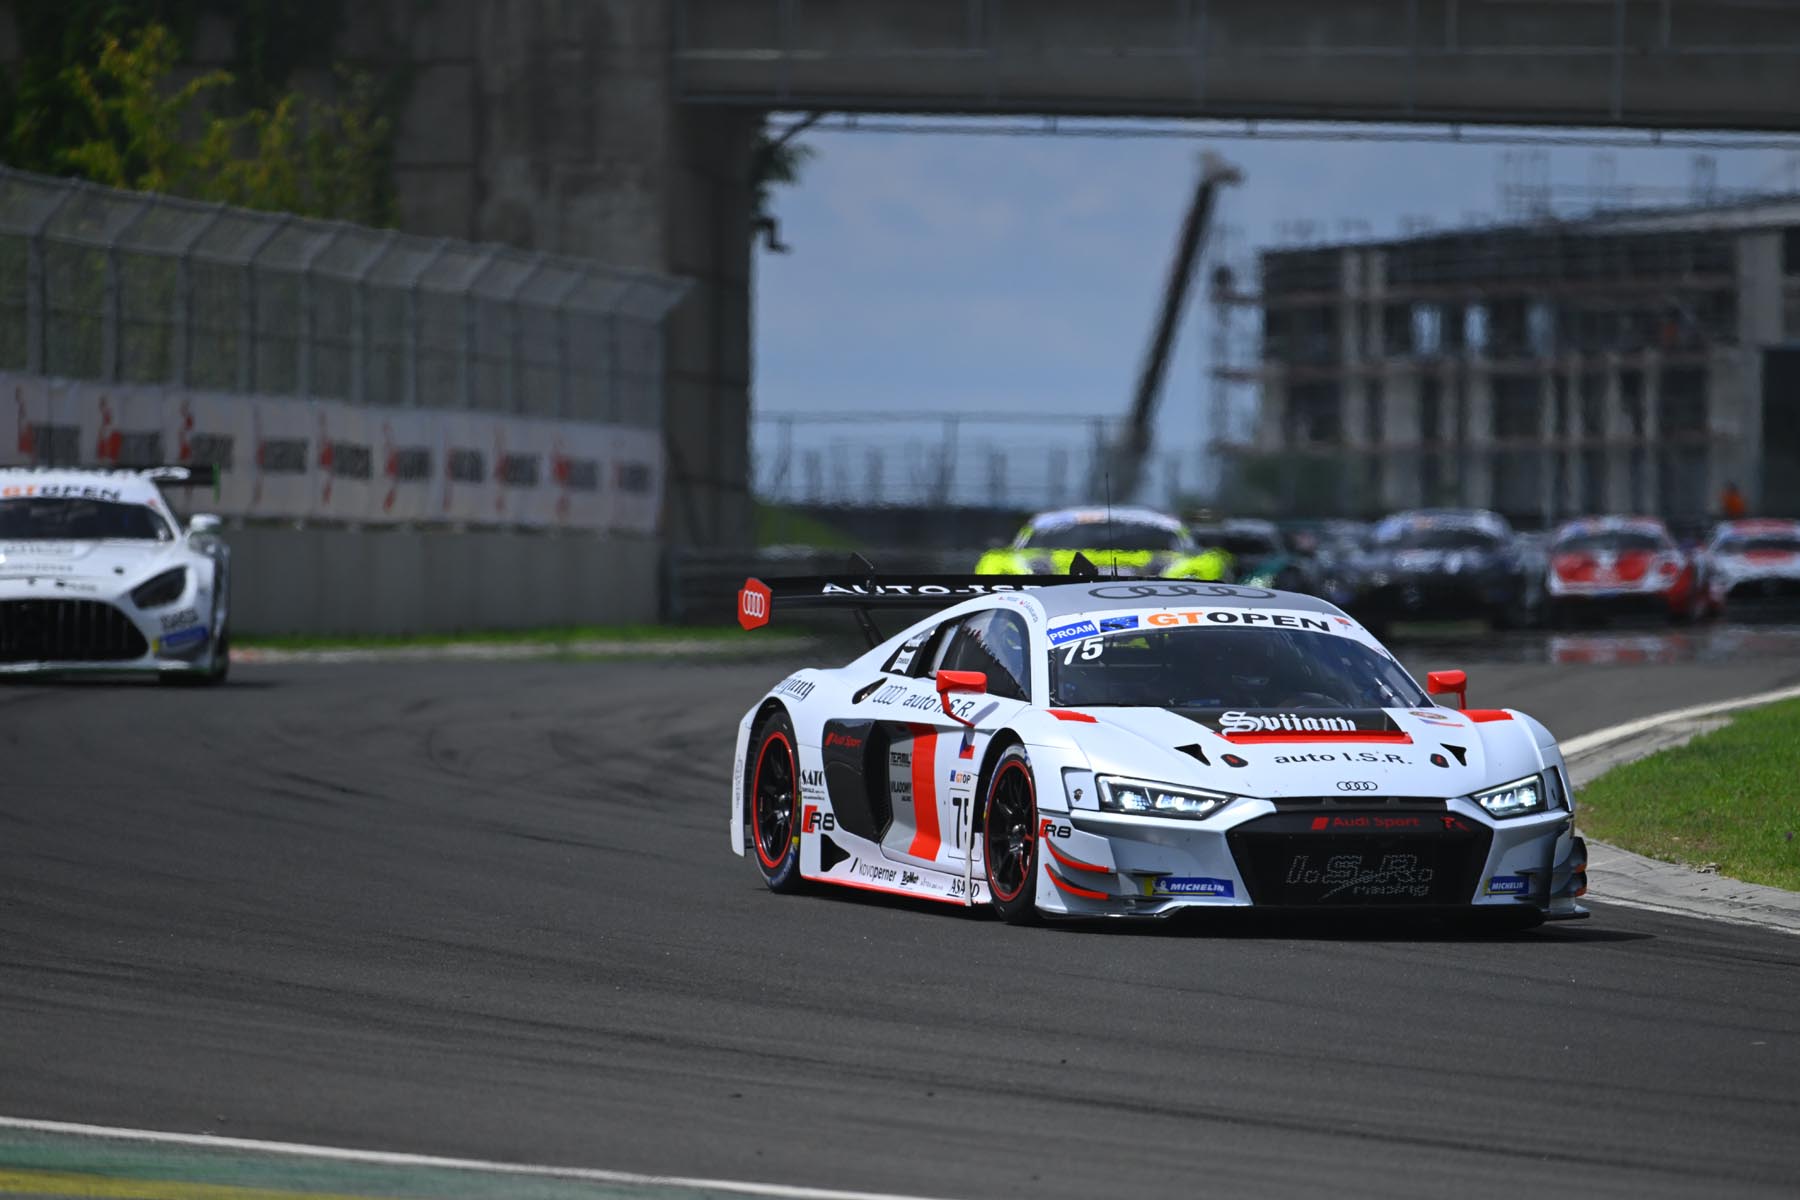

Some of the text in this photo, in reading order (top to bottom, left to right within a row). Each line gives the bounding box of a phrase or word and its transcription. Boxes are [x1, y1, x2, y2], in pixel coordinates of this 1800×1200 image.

[822, 583, 1043, 594] AUTO-IS
[1050, 623, 1095, 641] PROAM
[1059, 637, 1103, 666] 75
[903, 693, 937, 711] auto
[1274, 752, 1412, 765] auto I.S.R.
[809, 812, 835, 831] R8
[1332, 817, 1420, 828] Audi Sport
[1044, 823, 1071, 839] R8
[951, 878, 980, 898] ASAD
[1170, 882, 1225, 892] MICHELIN
[1491, 881, 1524, 891] MICHELIN
